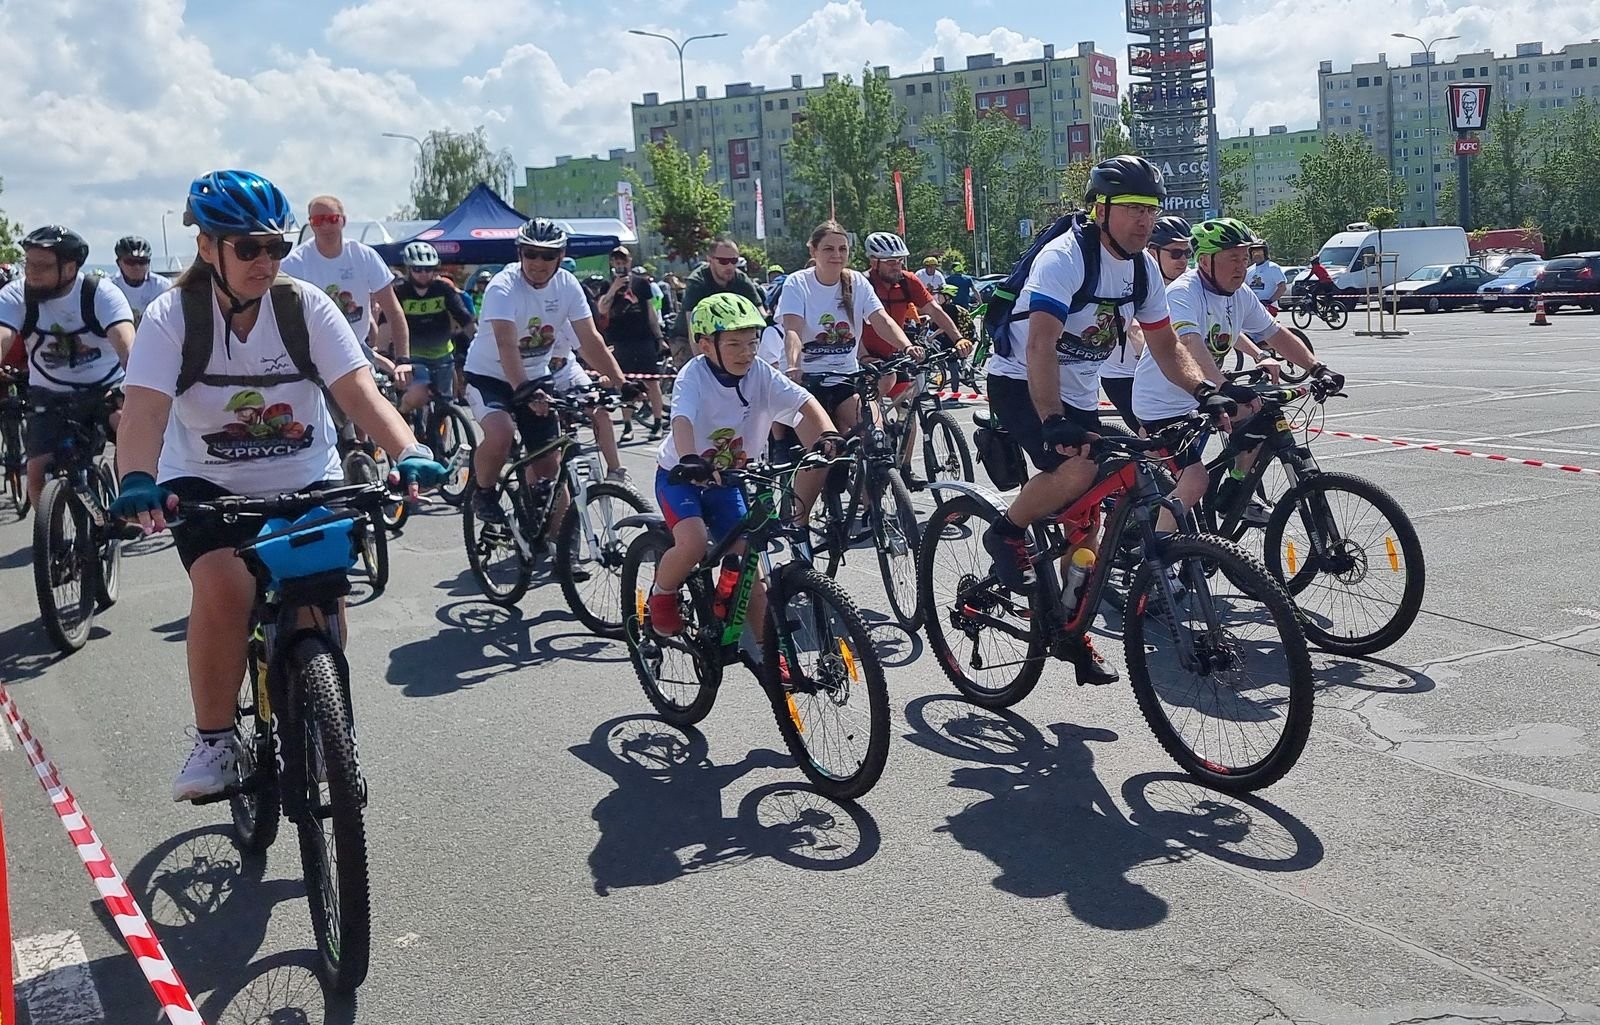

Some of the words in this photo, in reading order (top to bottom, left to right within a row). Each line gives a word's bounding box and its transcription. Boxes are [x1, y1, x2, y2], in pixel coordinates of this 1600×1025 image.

[1459, 142, 1478, 151] KFC
[1178, 161, 1210, 175] CCC
[1159, 196, 1210, 211] lfPrice
[409, 299, 442, 313] FOX
[213, 445, 300, 458] ZPRYCH
